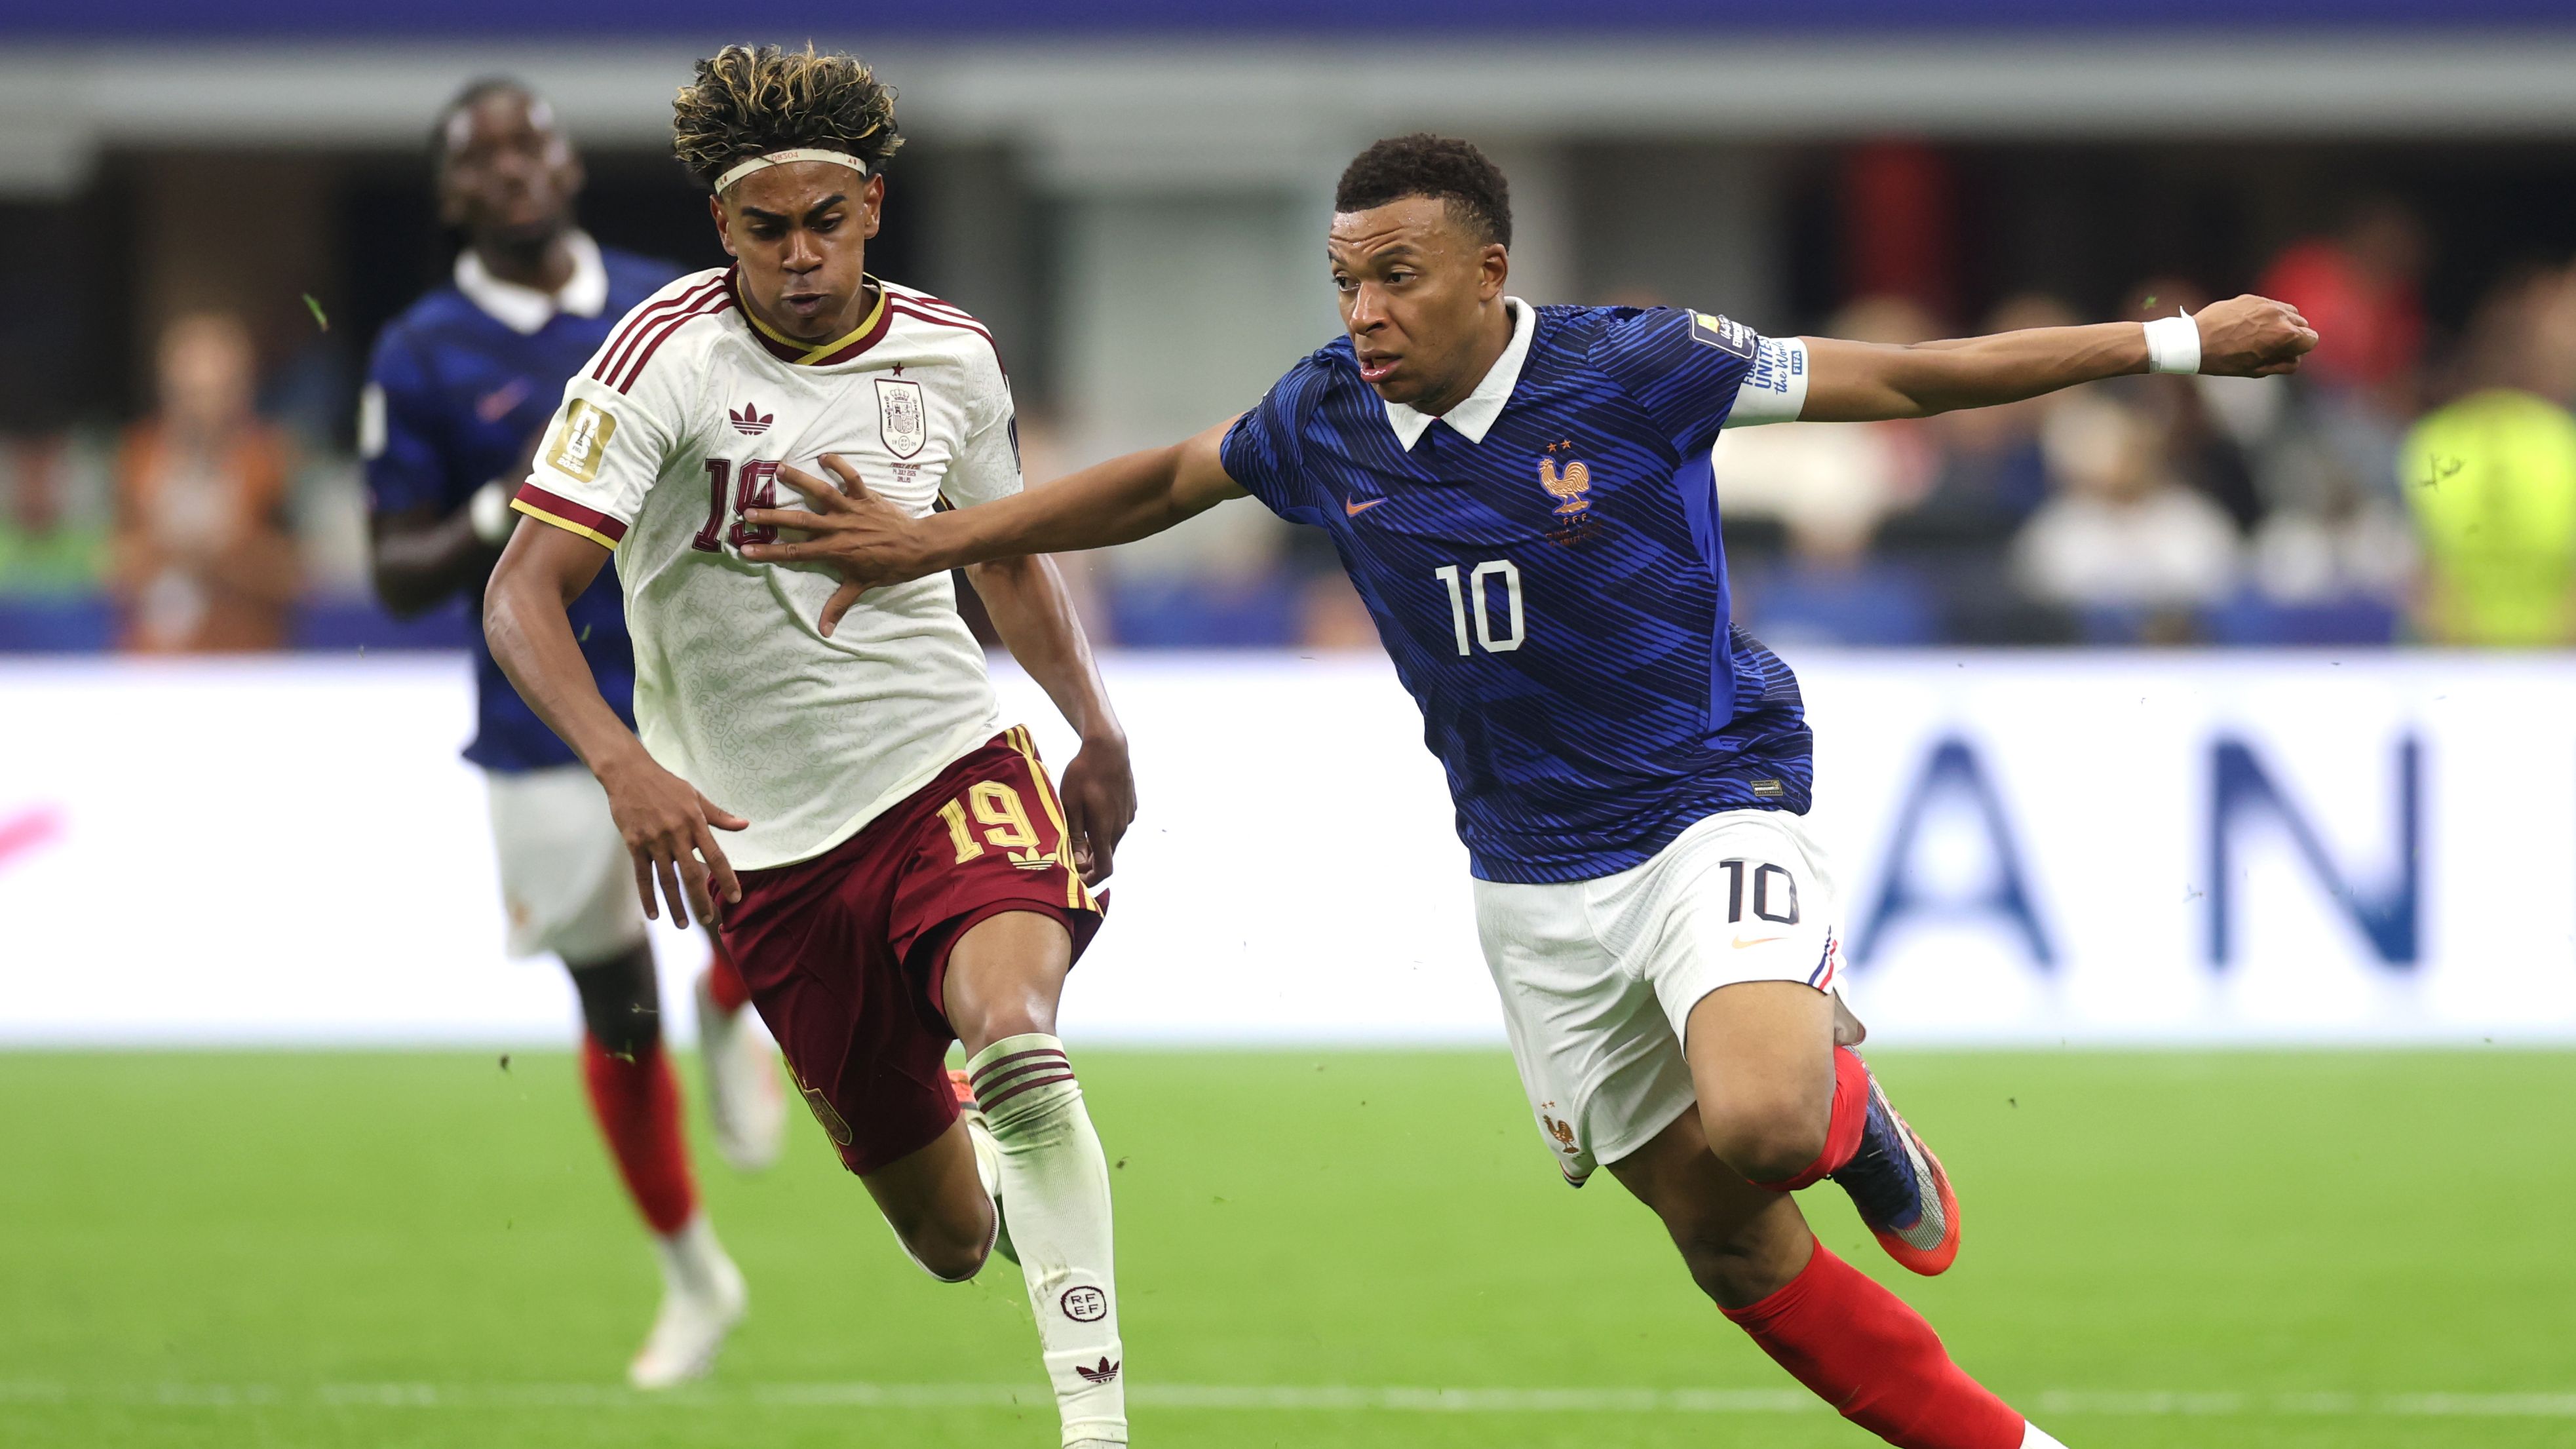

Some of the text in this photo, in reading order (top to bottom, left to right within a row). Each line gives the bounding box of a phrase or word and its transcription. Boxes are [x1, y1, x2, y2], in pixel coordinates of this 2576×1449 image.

[1755, 337, 1772, 389] UNITES
[1773, 372, 1787, 395] the
[1792, 352, 1801, 374] FIFA
[556, 457, 583, 474] 2026
[1435, 559, 1526, 656] 10
[936, 780, 1041, 865] 19
[1720, 860, 1800, 925] 10
